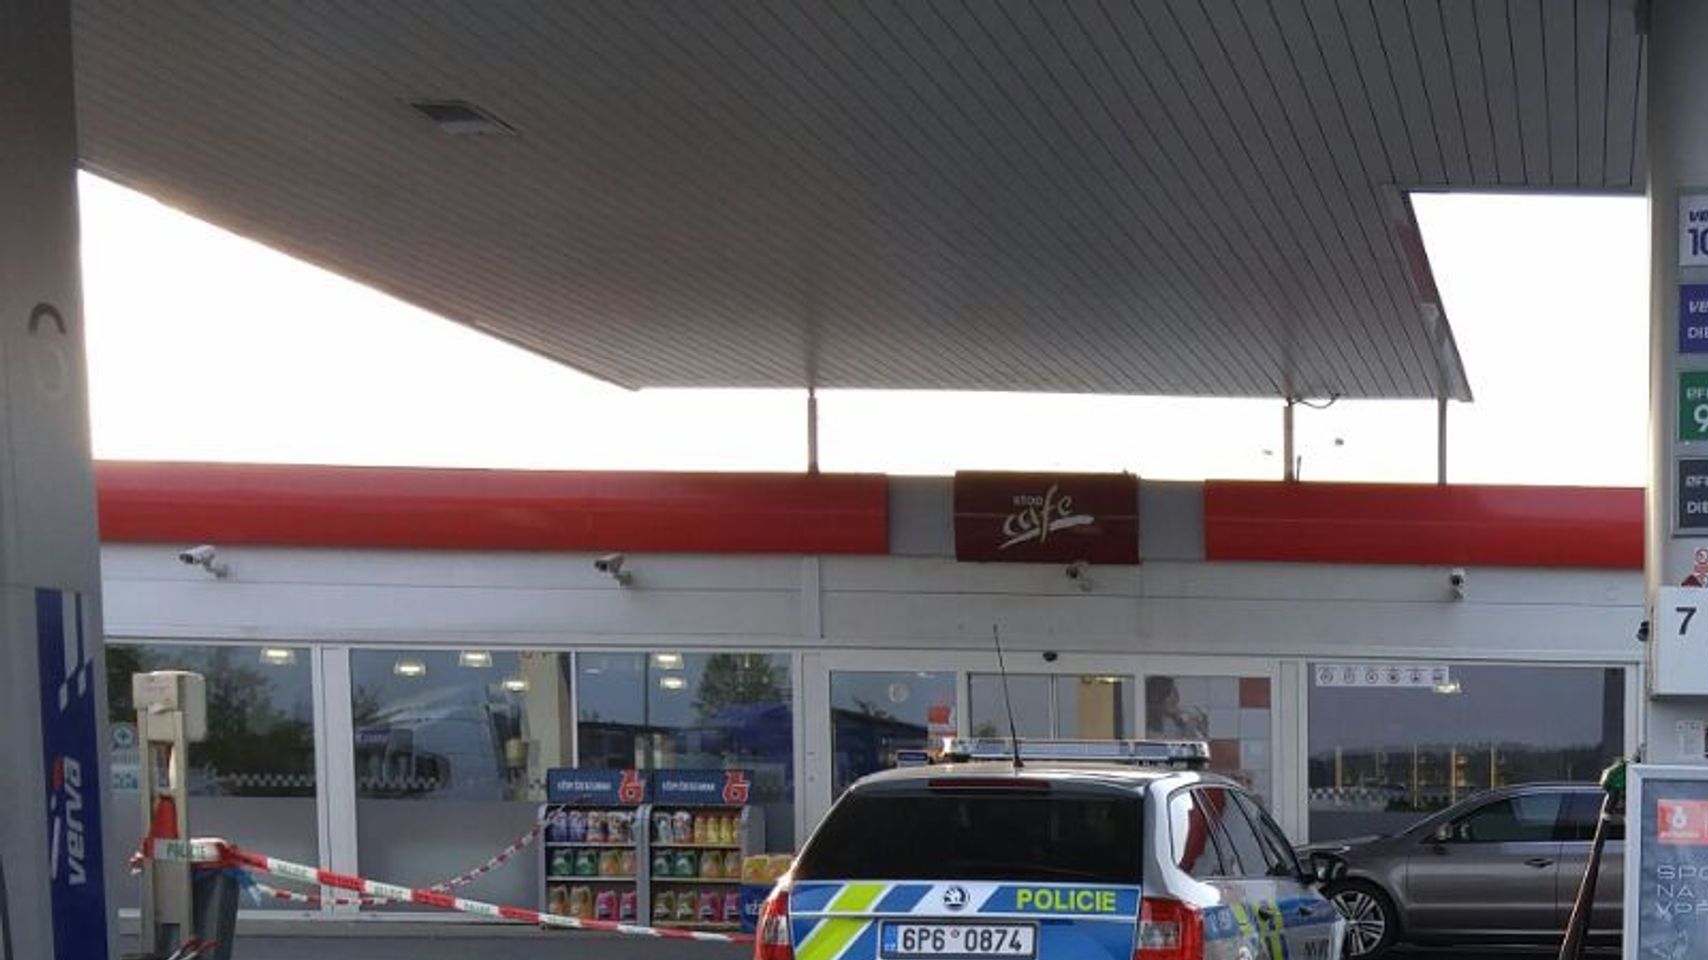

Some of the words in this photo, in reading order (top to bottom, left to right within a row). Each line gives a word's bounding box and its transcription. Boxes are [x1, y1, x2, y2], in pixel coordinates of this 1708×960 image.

[1675, 606, 1698, 636] 7
[63, 756, 87, 885] verva
[1016, 888, 1116, 912] POLICIE
[1656, 884, 1695, 899] NA
[902, 928, 946, 951] 6P6
[964, 929, 1022, 952] 0874
